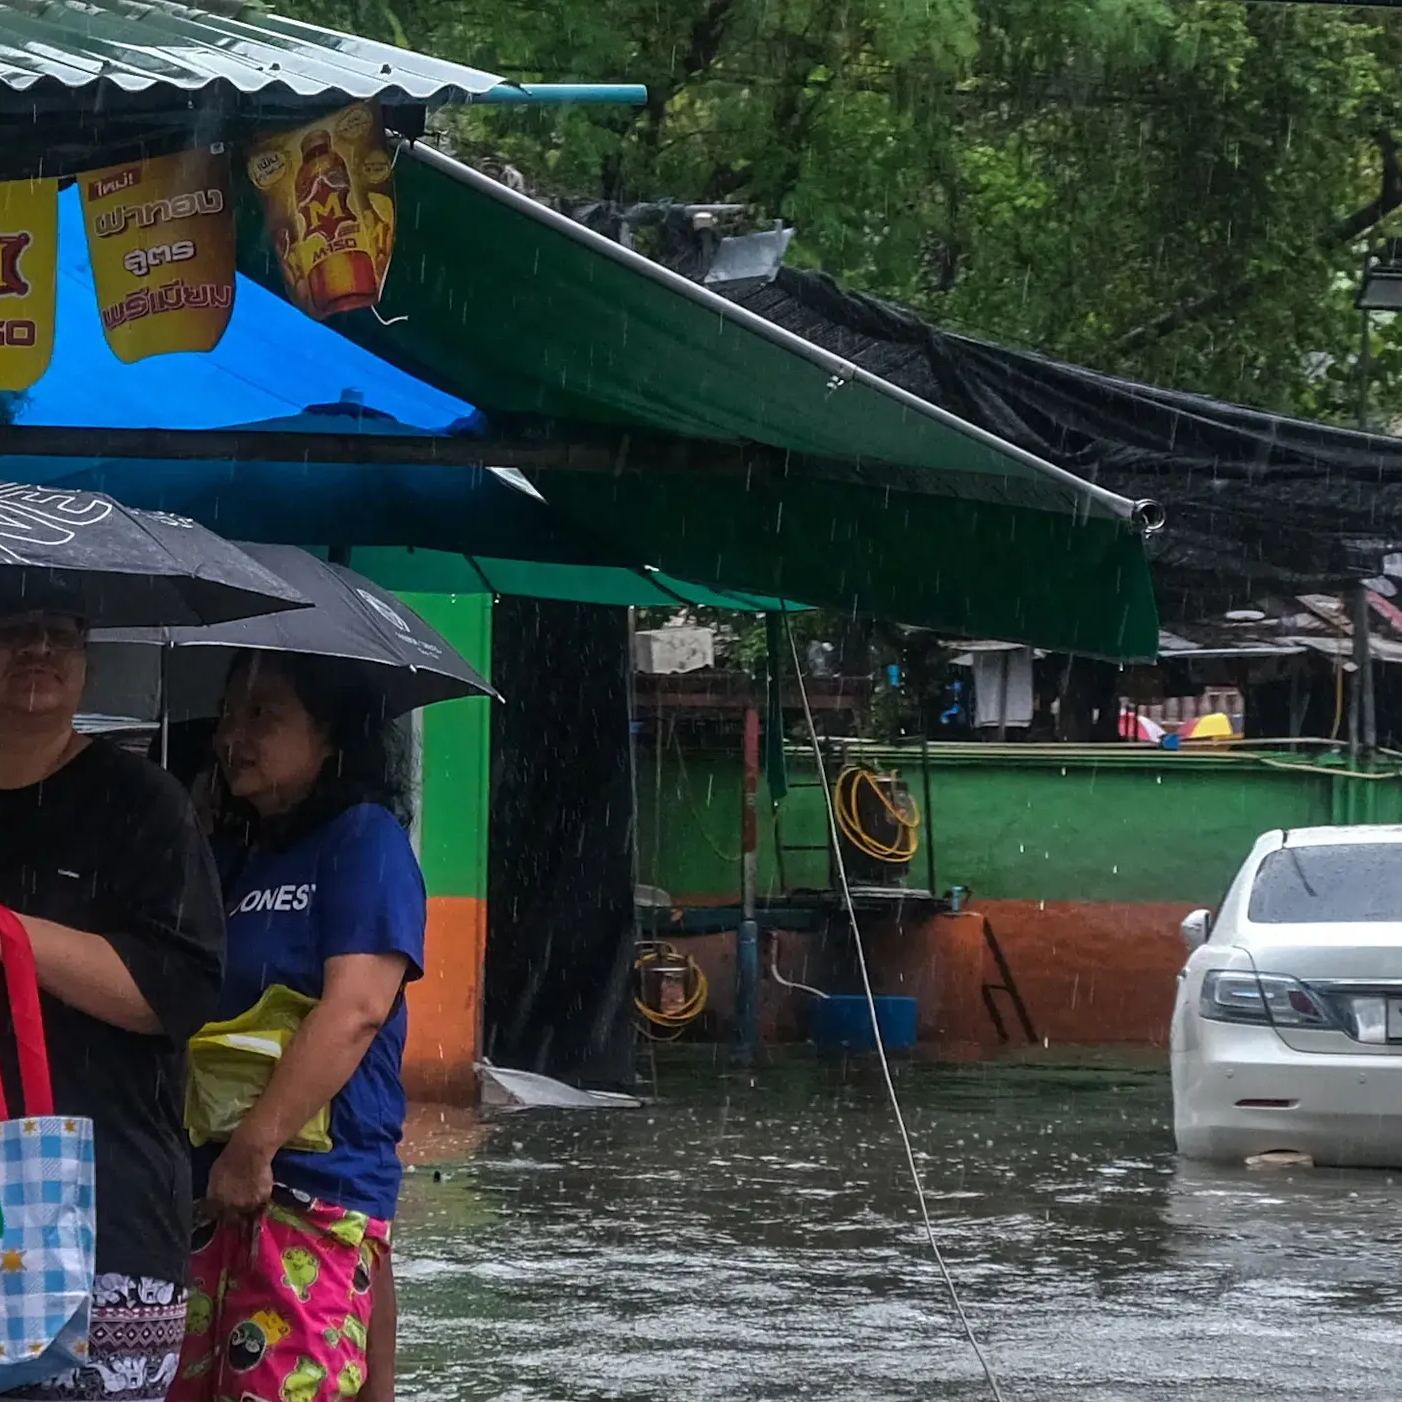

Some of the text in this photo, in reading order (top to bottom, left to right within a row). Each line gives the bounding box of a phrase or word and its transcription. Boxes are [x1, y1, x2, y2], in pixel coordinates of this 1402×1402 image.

[309, 191, 346, 230] M
[123, 239, 196, 277] สูตร
[312, 238, 357, 263] M-150
